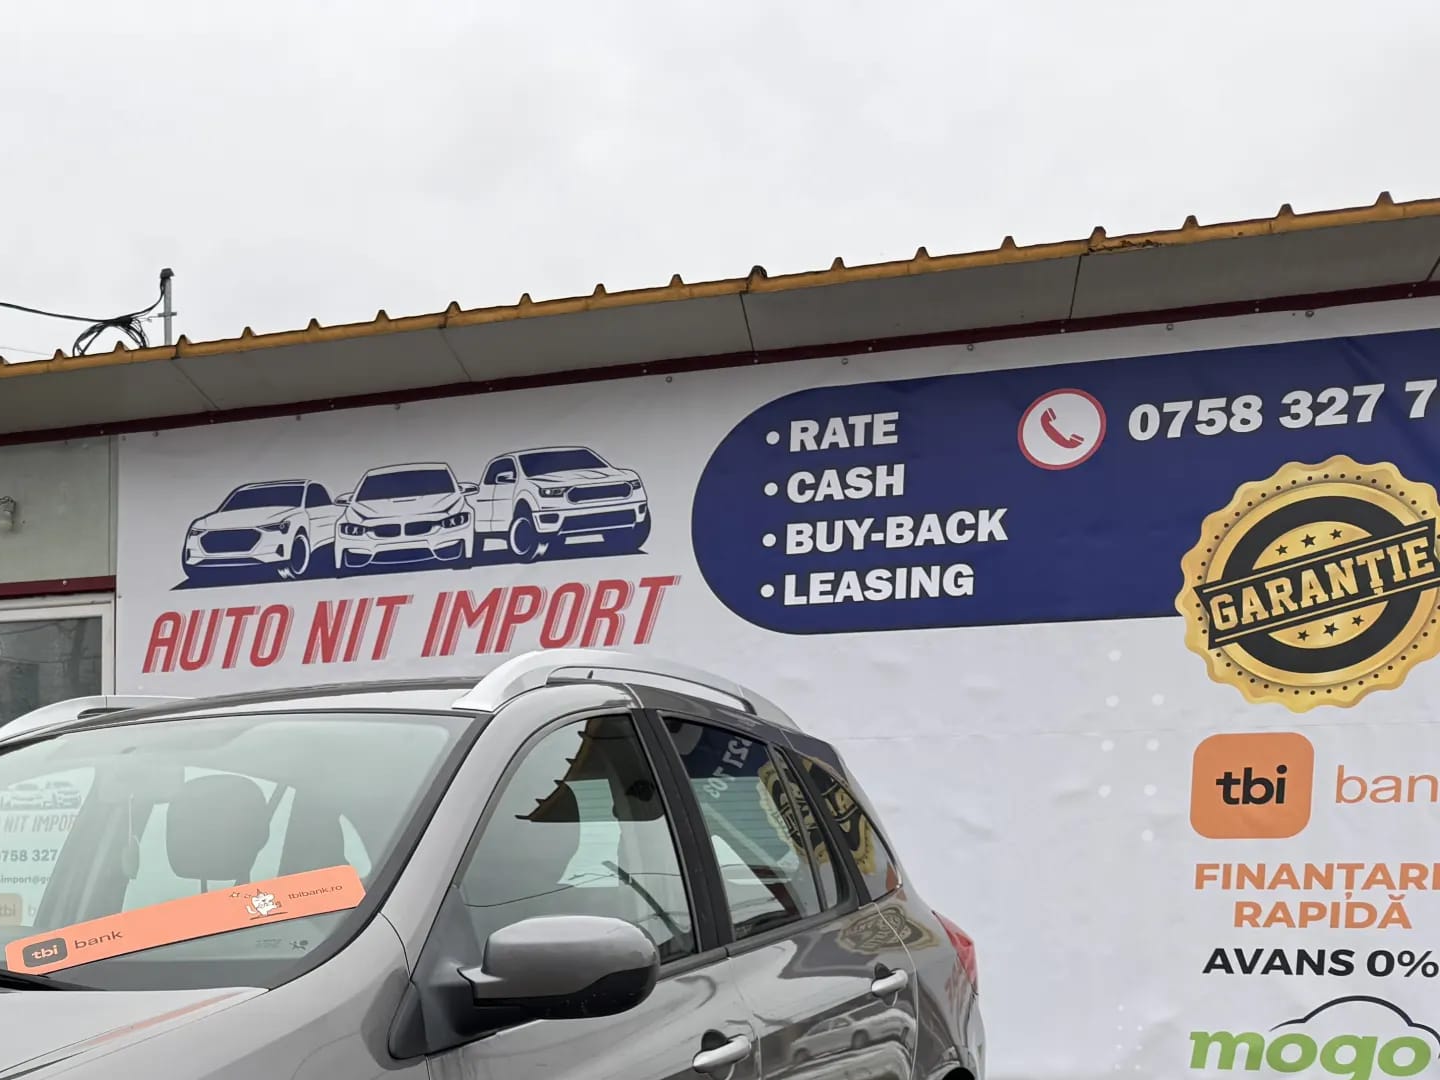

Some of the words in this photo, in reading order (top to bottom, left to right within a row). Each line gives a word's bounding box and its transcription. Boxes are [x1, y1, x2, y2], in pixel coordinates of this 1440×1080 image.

[789, 412, 899, 452] RATE
[1128, 395, 1262, 440] 0758
[1278, 384, 1385, 430] 327
[786, 464, 905, 504] CASH
[784, 508, 1008, 555] BUY-BACK
[783, 563, 975, 606] LEASING
[142, 603, 296, 673] AUTO
[302, 594, 413, 664] NIT
[421, 575, 681, 657] IMPORT
[1215, 764, 1288, 805] tbi
[32, 848, 58, 861] 327
[1233, 893, 1413, 929] RAPIDĂ
[31, 945, 58, 959] tbi
[74, 931, 123, 949] bank
[1202, 947, 1355, 976] AVANS
[1366, 949, 1439, 979] 0%
